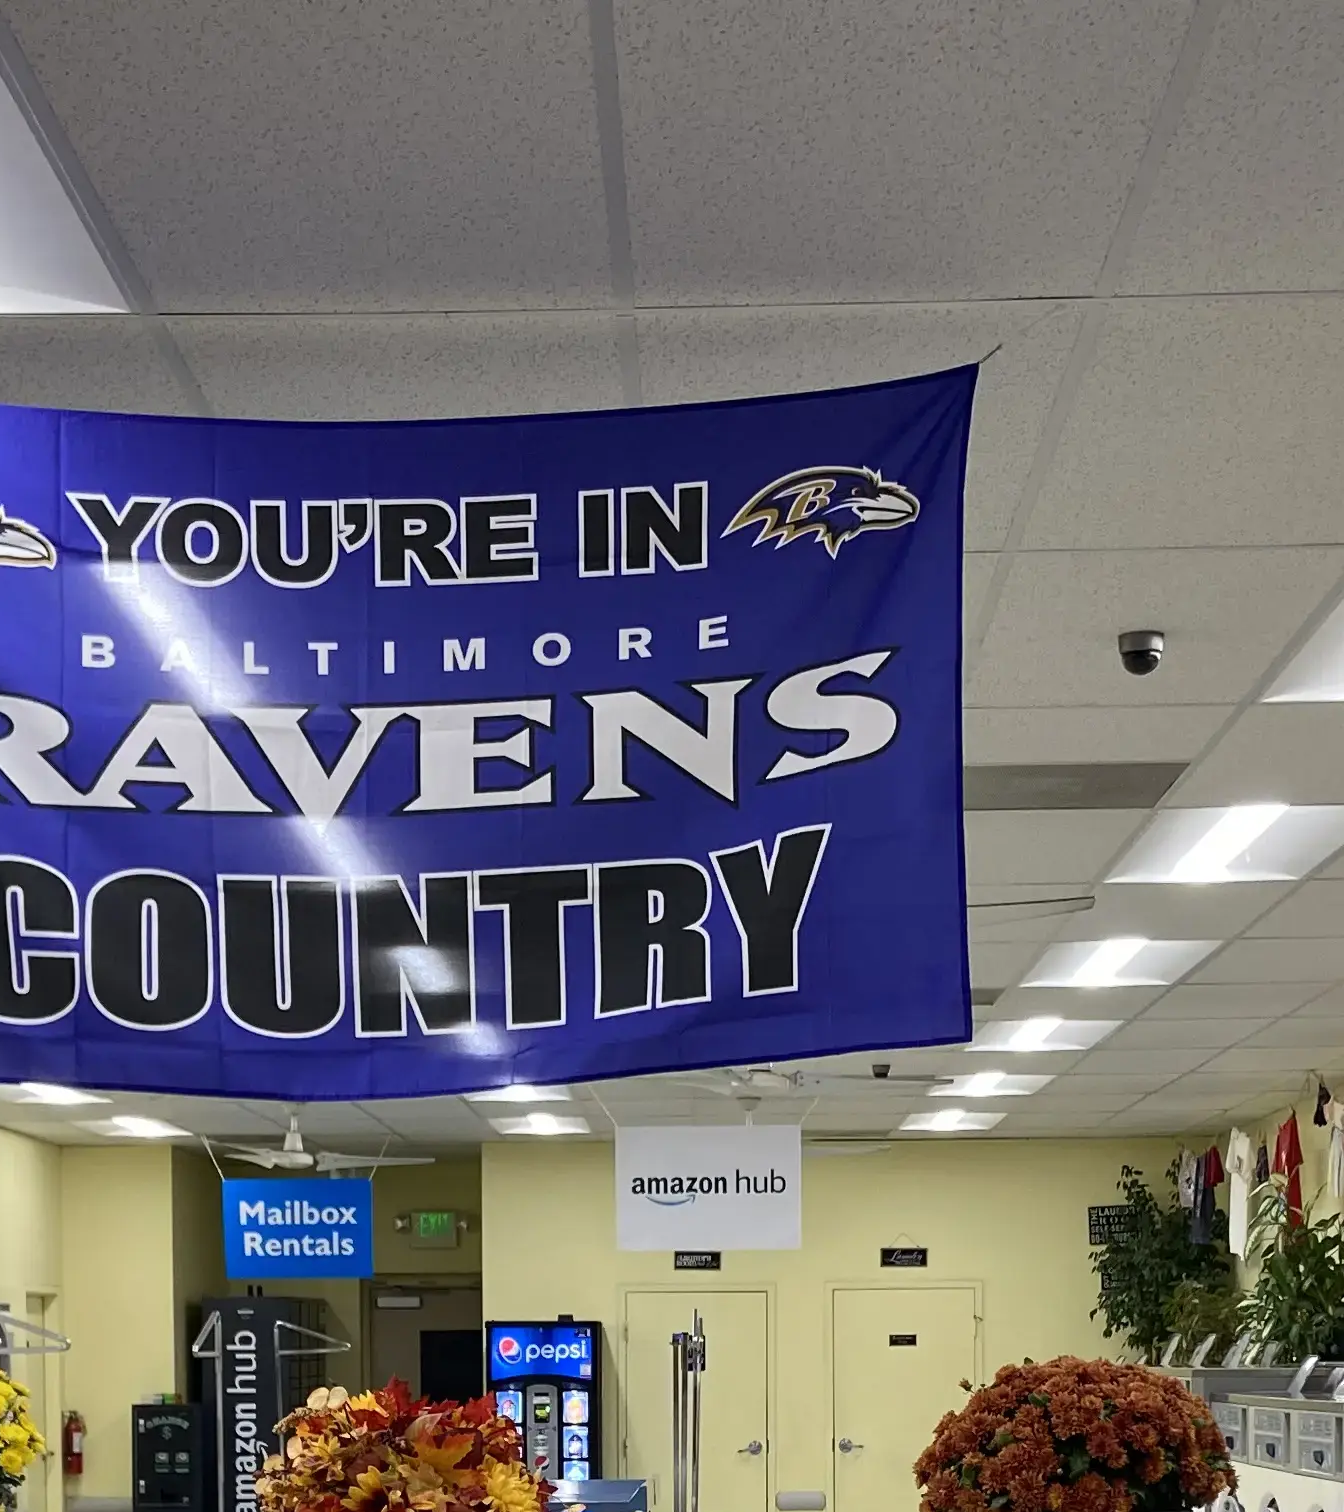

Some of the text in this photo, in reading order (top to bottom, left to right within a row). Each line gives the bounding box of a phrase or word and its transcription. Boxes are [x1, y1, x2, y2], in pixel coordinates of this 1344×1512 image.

[68, 481, 709, 588] YOU'RE IN
[81, 615, 730, 677] BALTIMORE
[632, 1168, 786, 1196] amazon hub
[239, 1200, 357, 1226] Mailbox
[243, 1231, 355, 1257] Rentals
[227, 1329, 257, 1394] hub
[525, 1340, 588, 1364] pepsi
